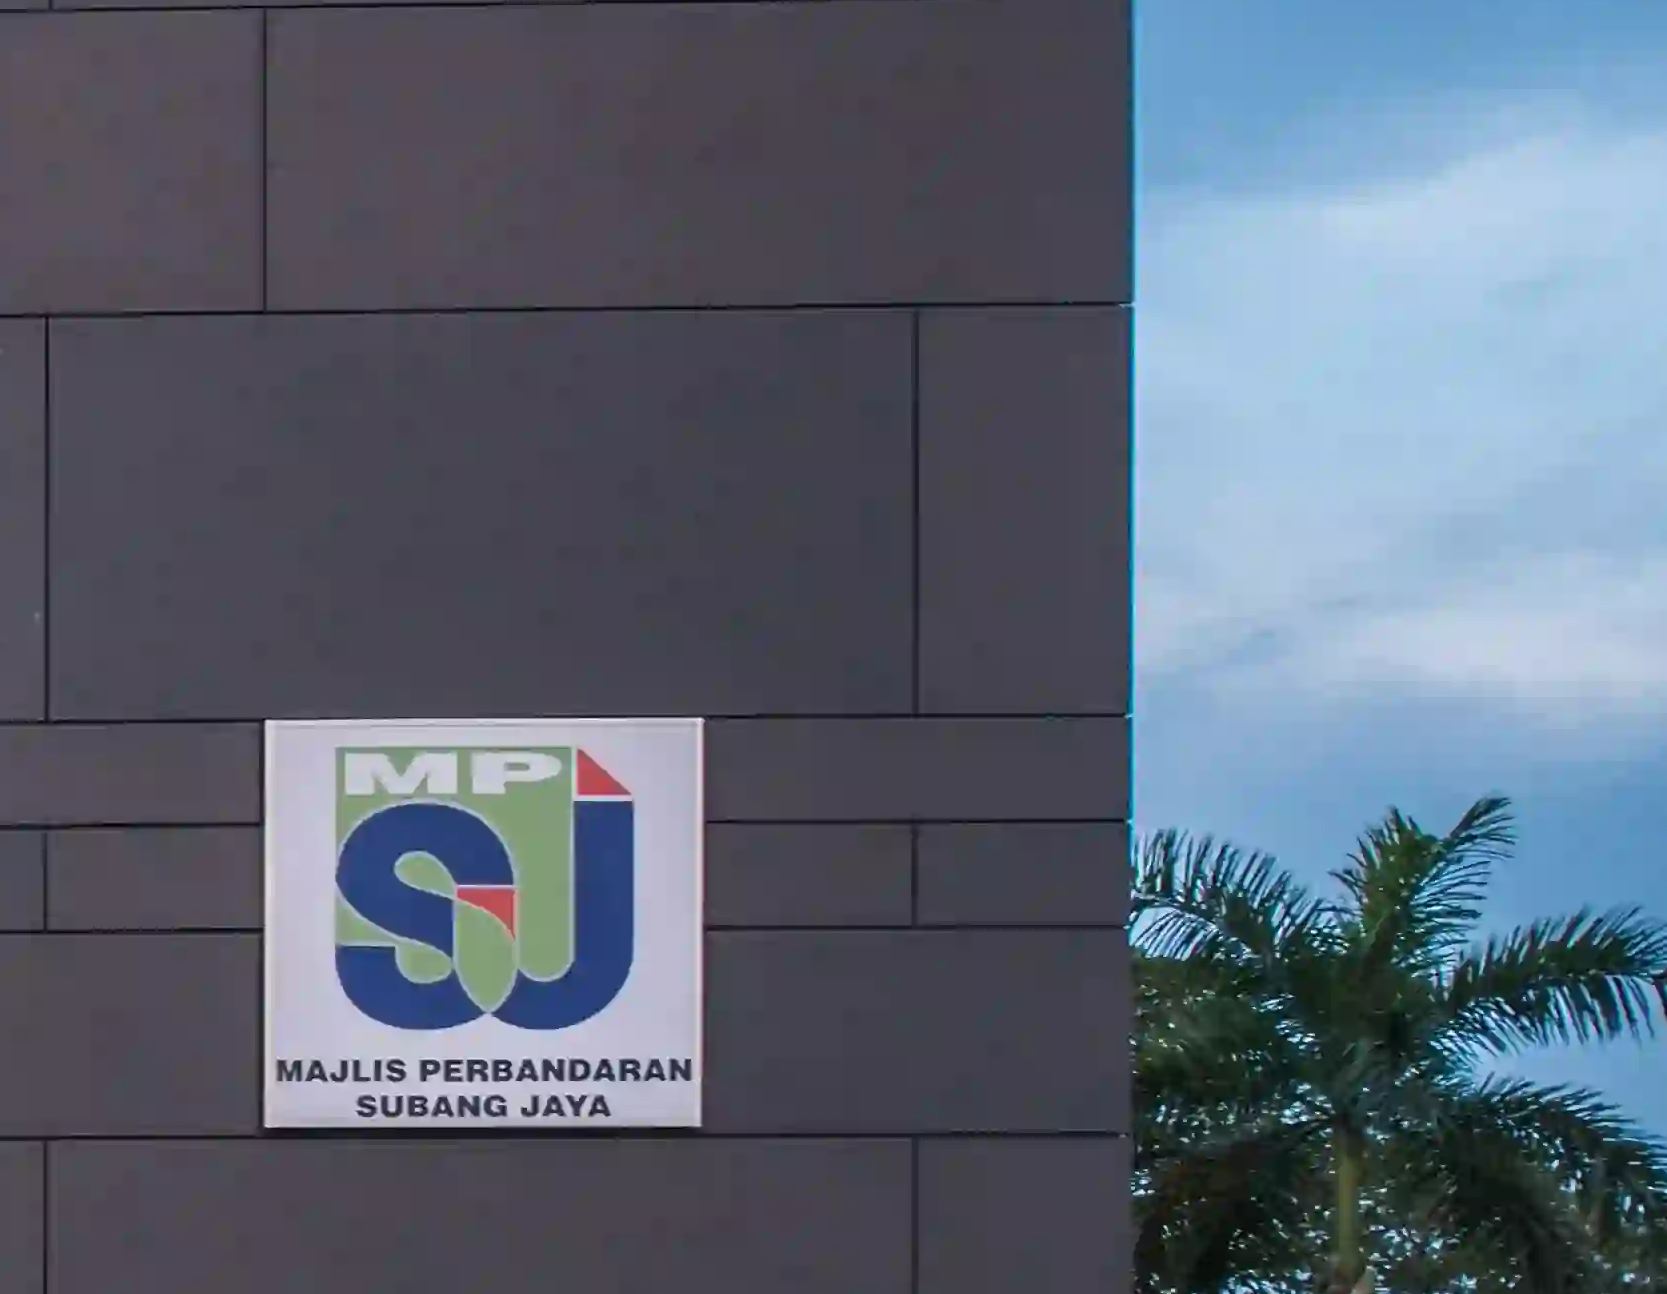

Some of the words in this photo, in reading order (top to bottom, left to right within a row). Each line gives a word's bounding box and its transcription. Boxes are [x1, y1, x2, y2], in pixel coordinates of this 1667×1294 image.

[344, 751, 563, 795] MP
[275, 1058, 408, 1083] MAJLIS
[419, 1057, 692, 1083] PERBANDARAN
[355, 1094, 508, 1118] SUBANG
[520, 1094, 612, 1118] JAYA
